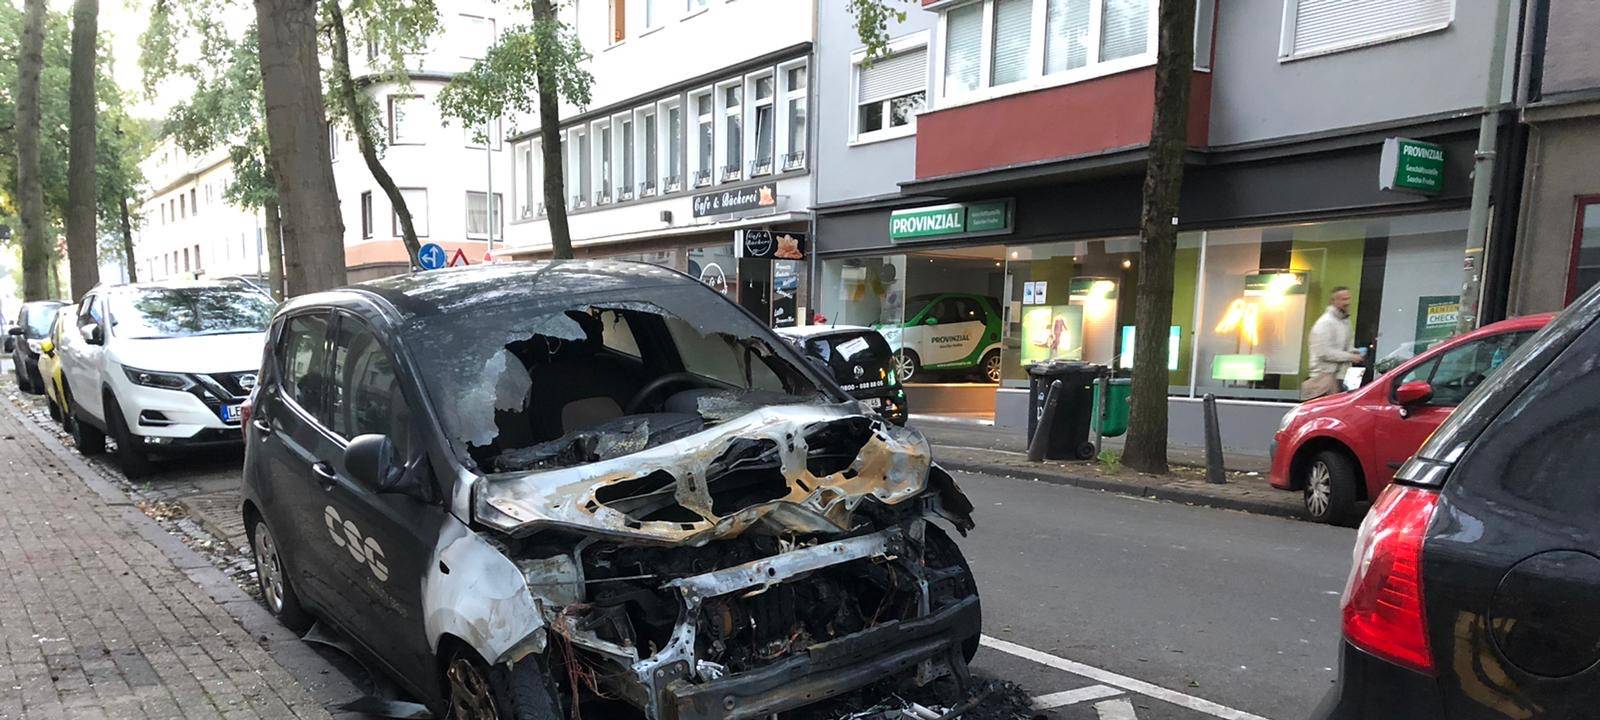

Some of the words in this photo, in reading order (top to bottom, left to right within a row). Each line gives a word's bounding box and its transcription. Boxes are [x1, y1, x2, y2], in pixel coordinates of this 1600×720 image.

[1403, 145, 1444, 161] PROVINZIAL
[713, 197, 720, 209] &
[721, 190, 758, 208] Bäckerei
[893, 212, 961, 234] PROVINZIAL
[1430, 315, 1455, 323] CHECK
[931, 335, 970, 344] PROVINZIAL
